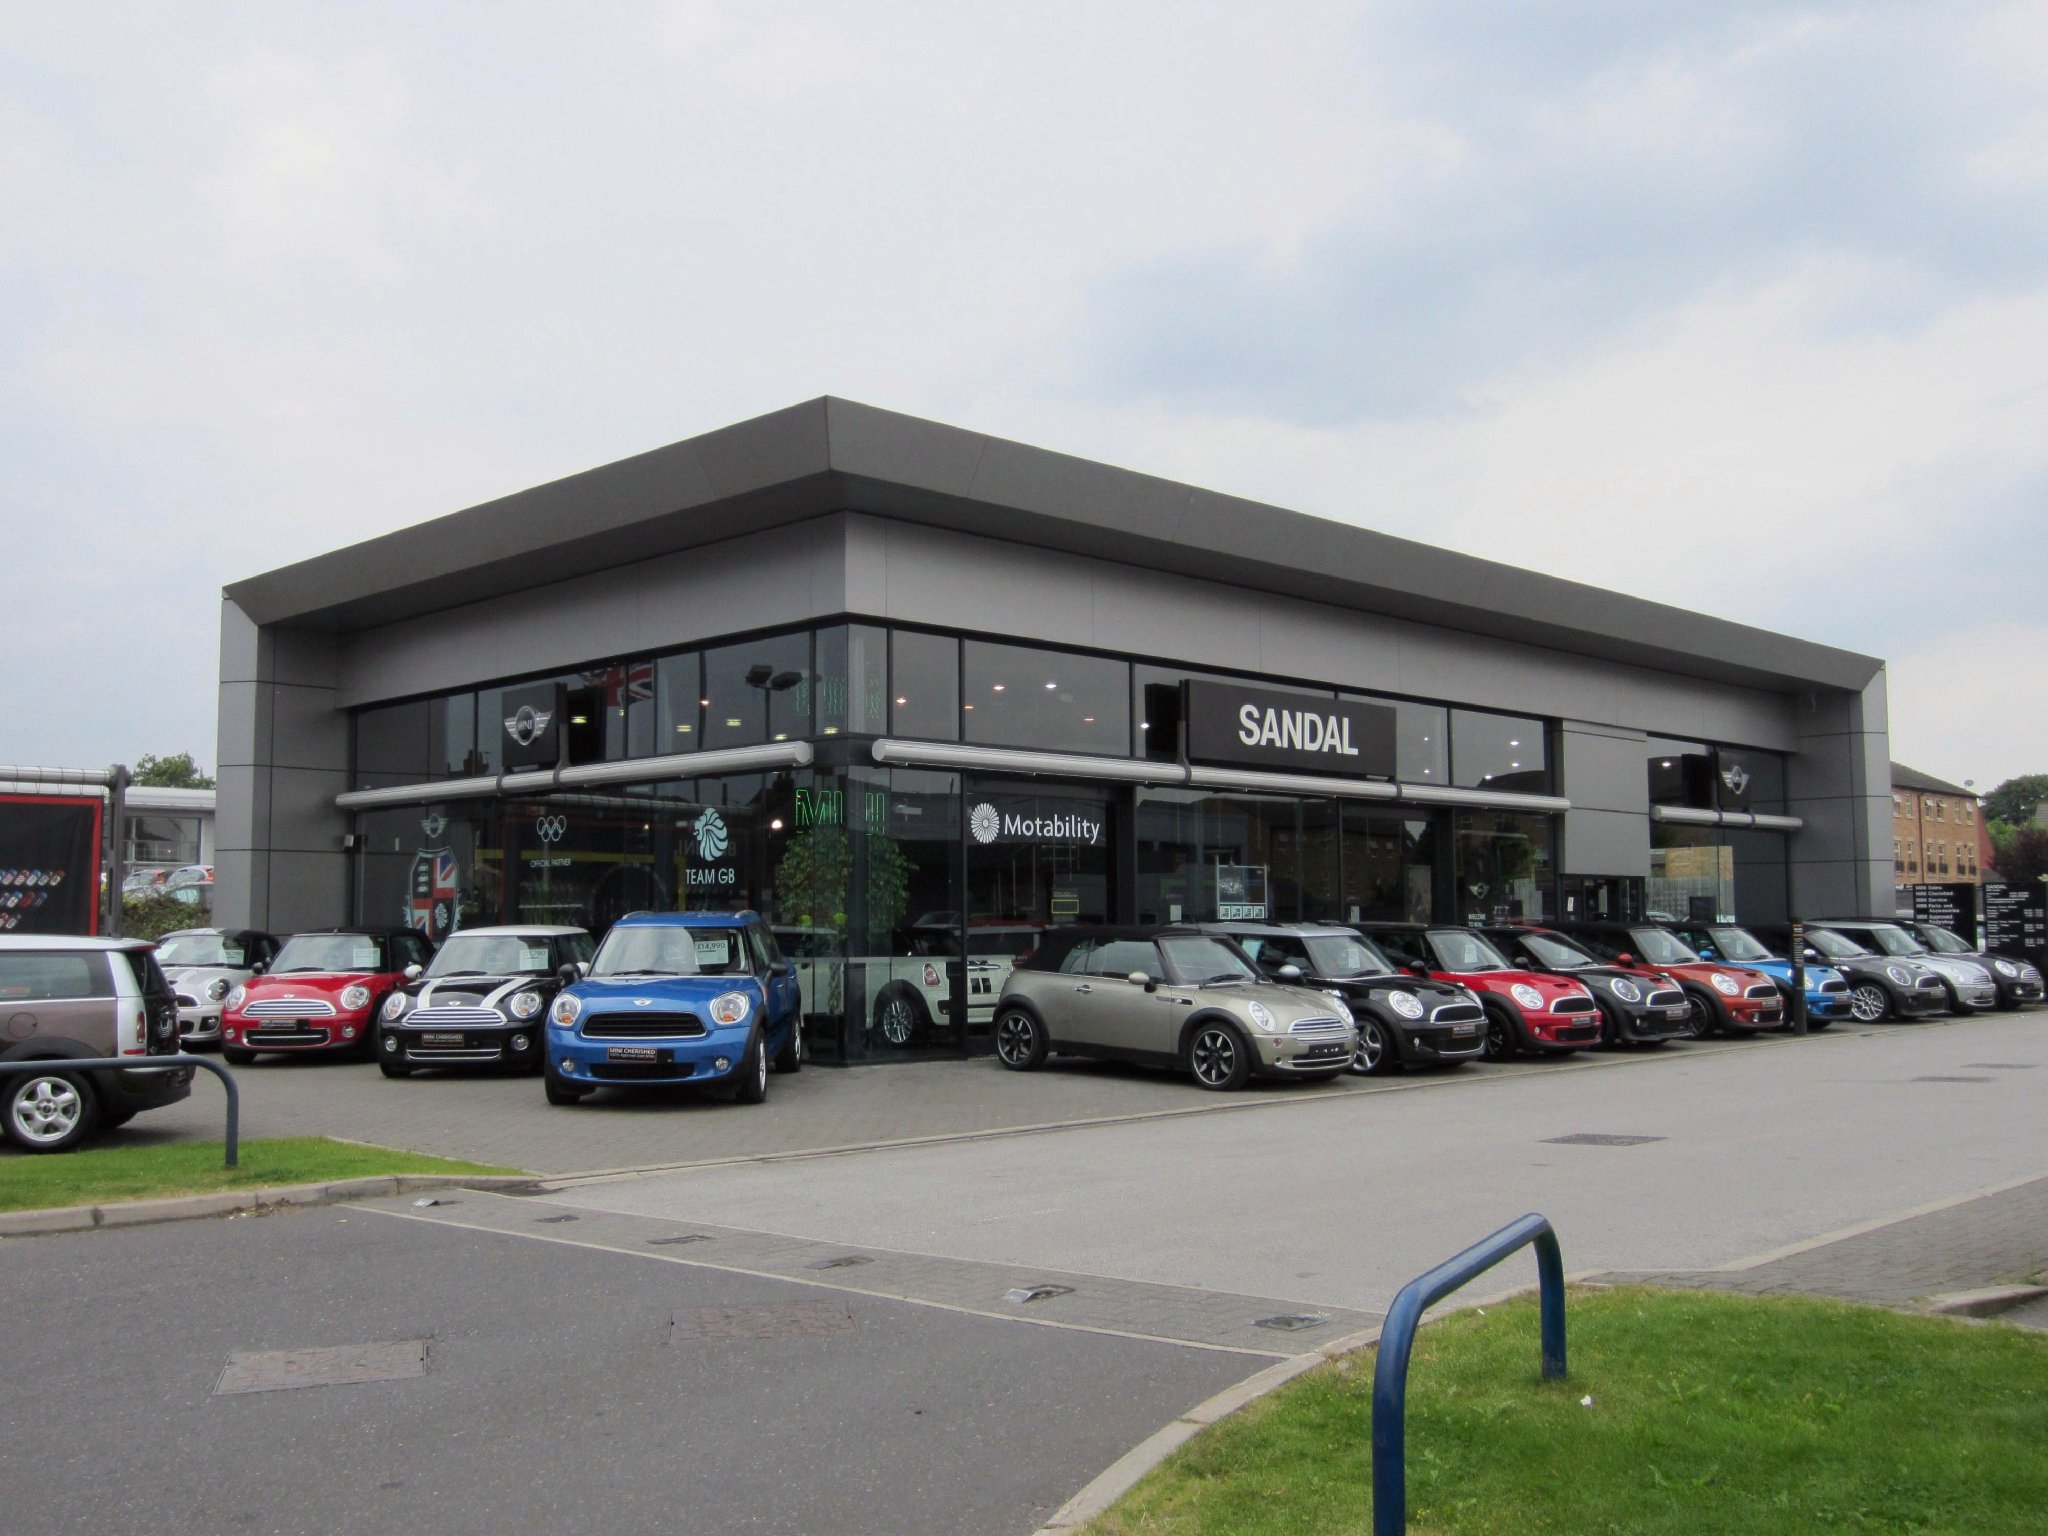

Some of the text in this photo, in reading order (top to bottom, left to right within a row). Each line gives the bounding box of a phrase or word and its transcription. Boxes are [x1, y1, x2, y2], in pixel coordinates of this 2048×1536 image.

[1239, 704, 1359, 755] SANDAL
[1004, 813, 1100, 845] Motability
[685, 868, 735, 885] TEAM GB
[697, 942, 726, 950] £14,990
